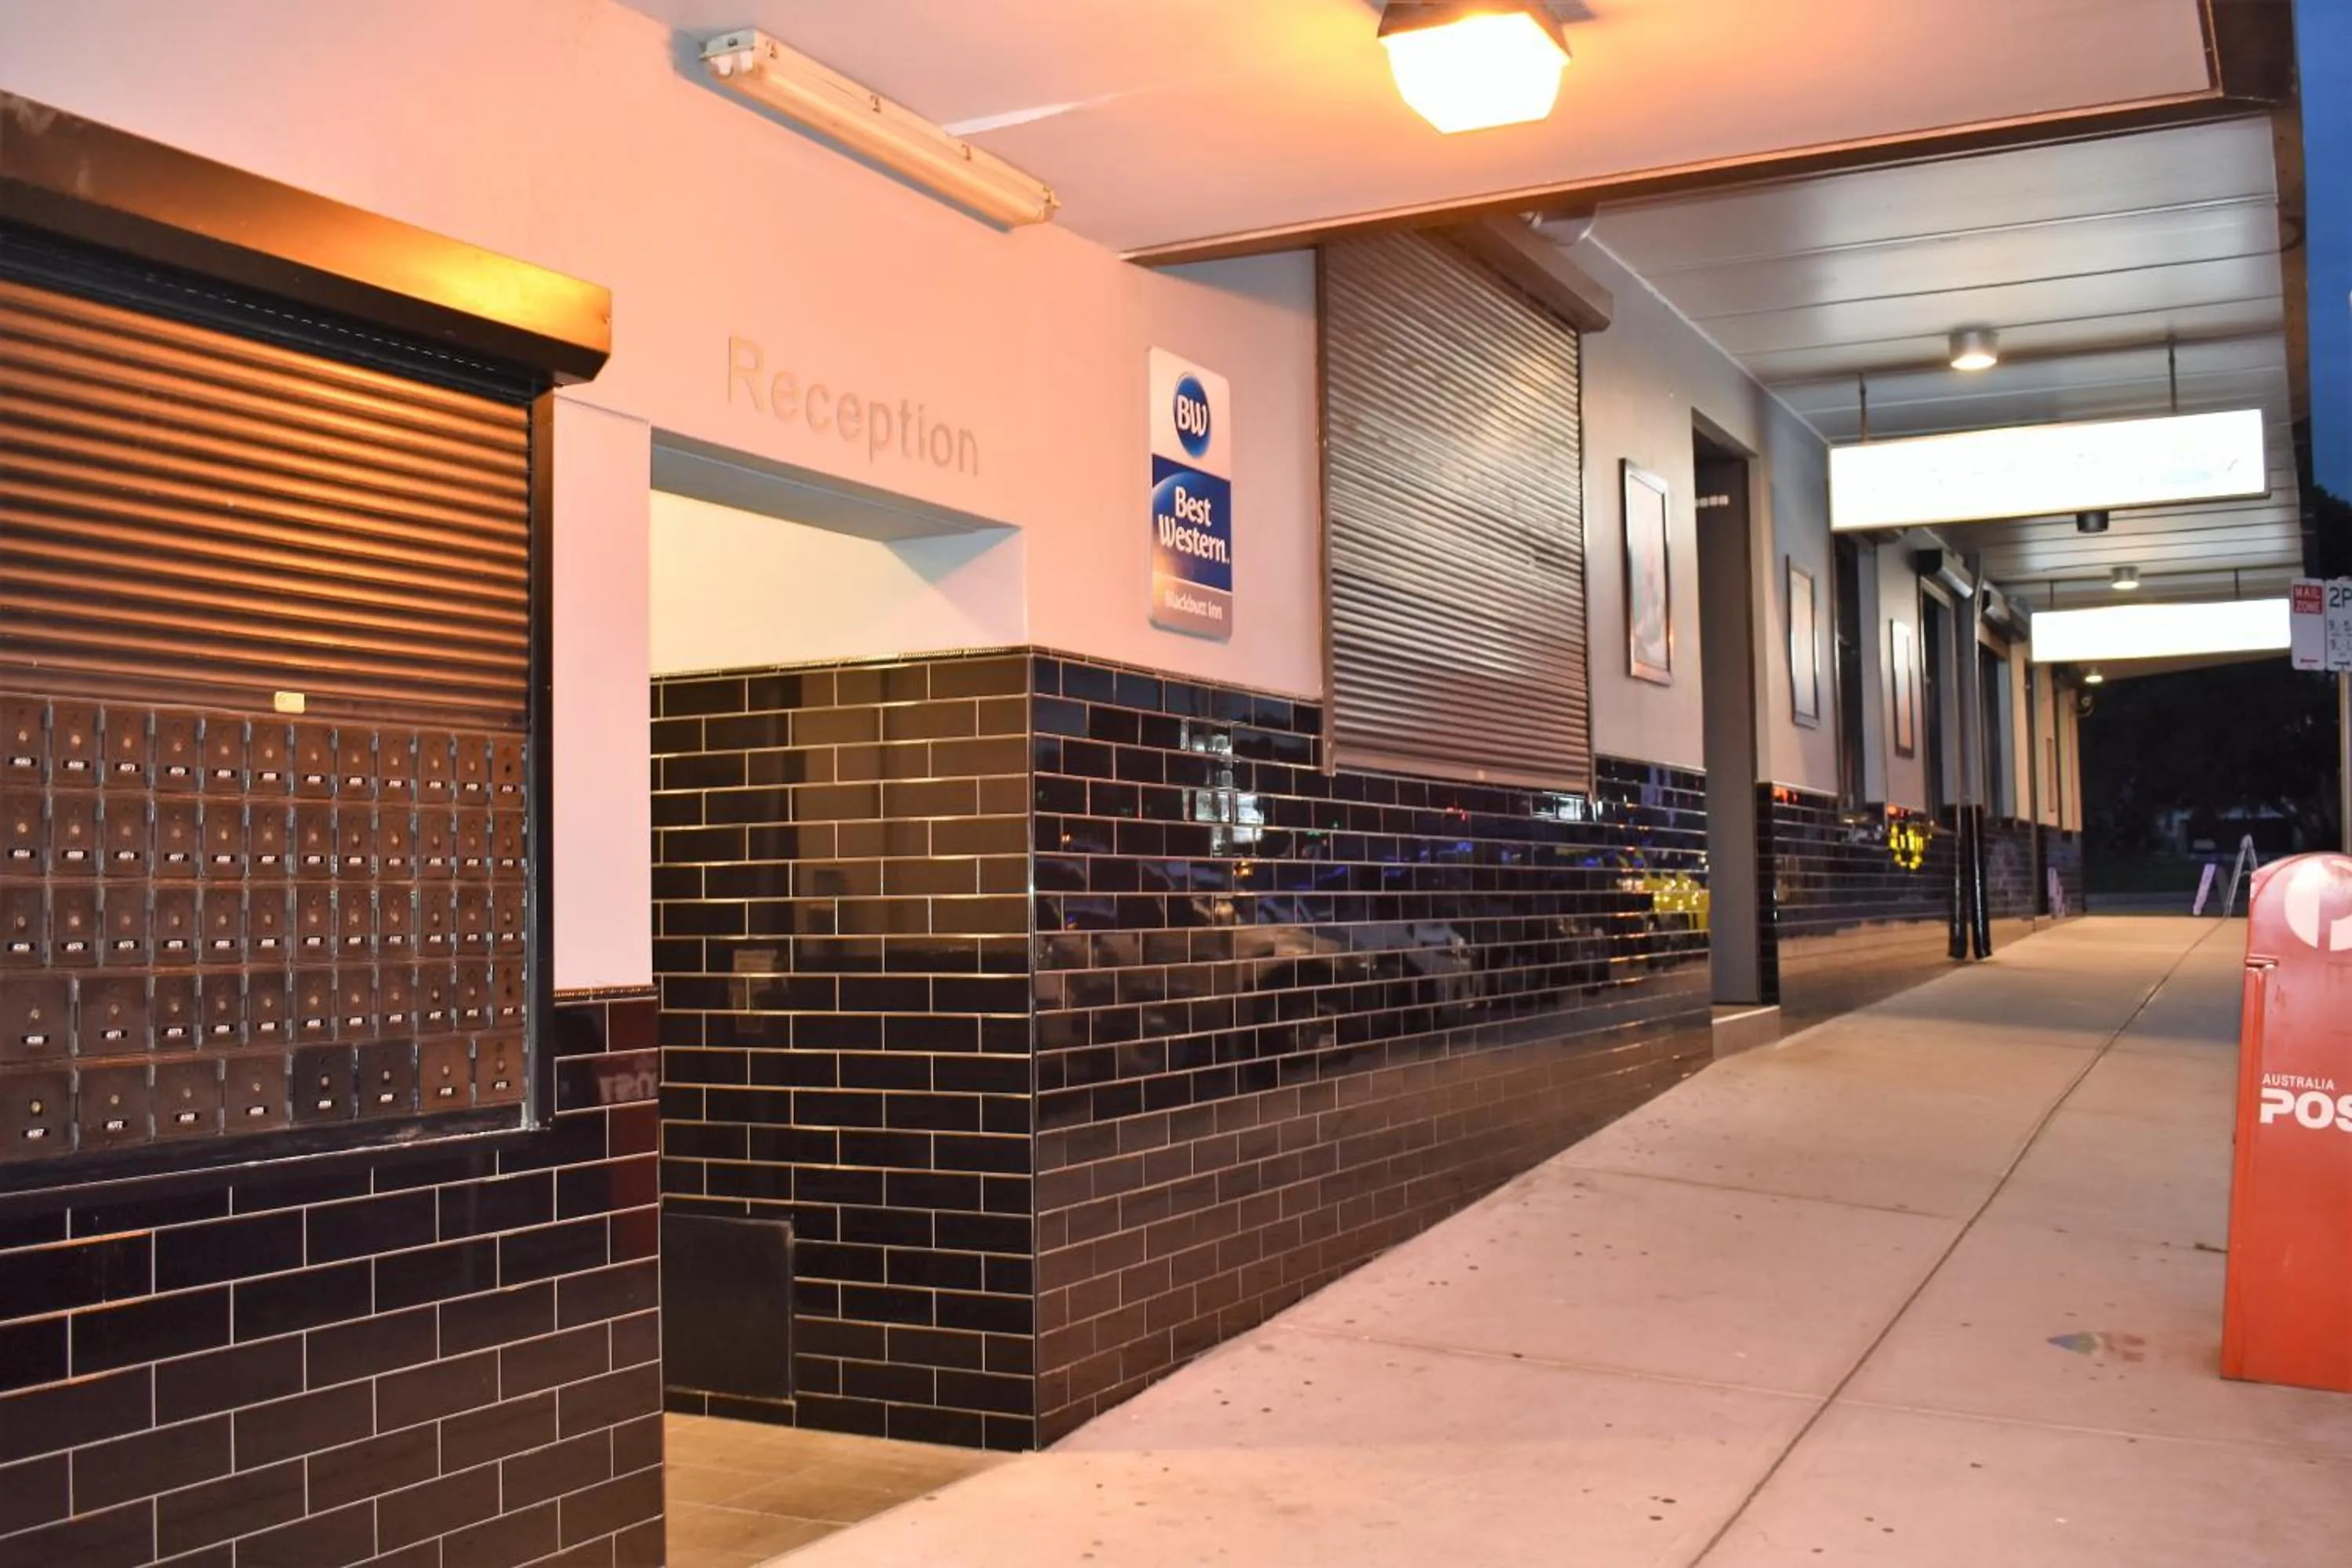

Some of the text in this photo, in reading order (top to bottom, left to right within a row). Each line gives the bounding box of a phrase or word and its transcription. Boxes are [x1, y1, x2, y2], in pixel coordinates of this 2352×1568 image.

[728, 336, 979, 477] Reception
[1177, 394, 1207, 437] BW
[1175, 485, 1212, 528] Best
[2294, 586, 2321, 600] MAIL
[1208, 599, 1223, 621] Inn
[2294, 600, 2321, 613] ZONE
[2262, 1073, 2335, 1091] AUSTRALIA
